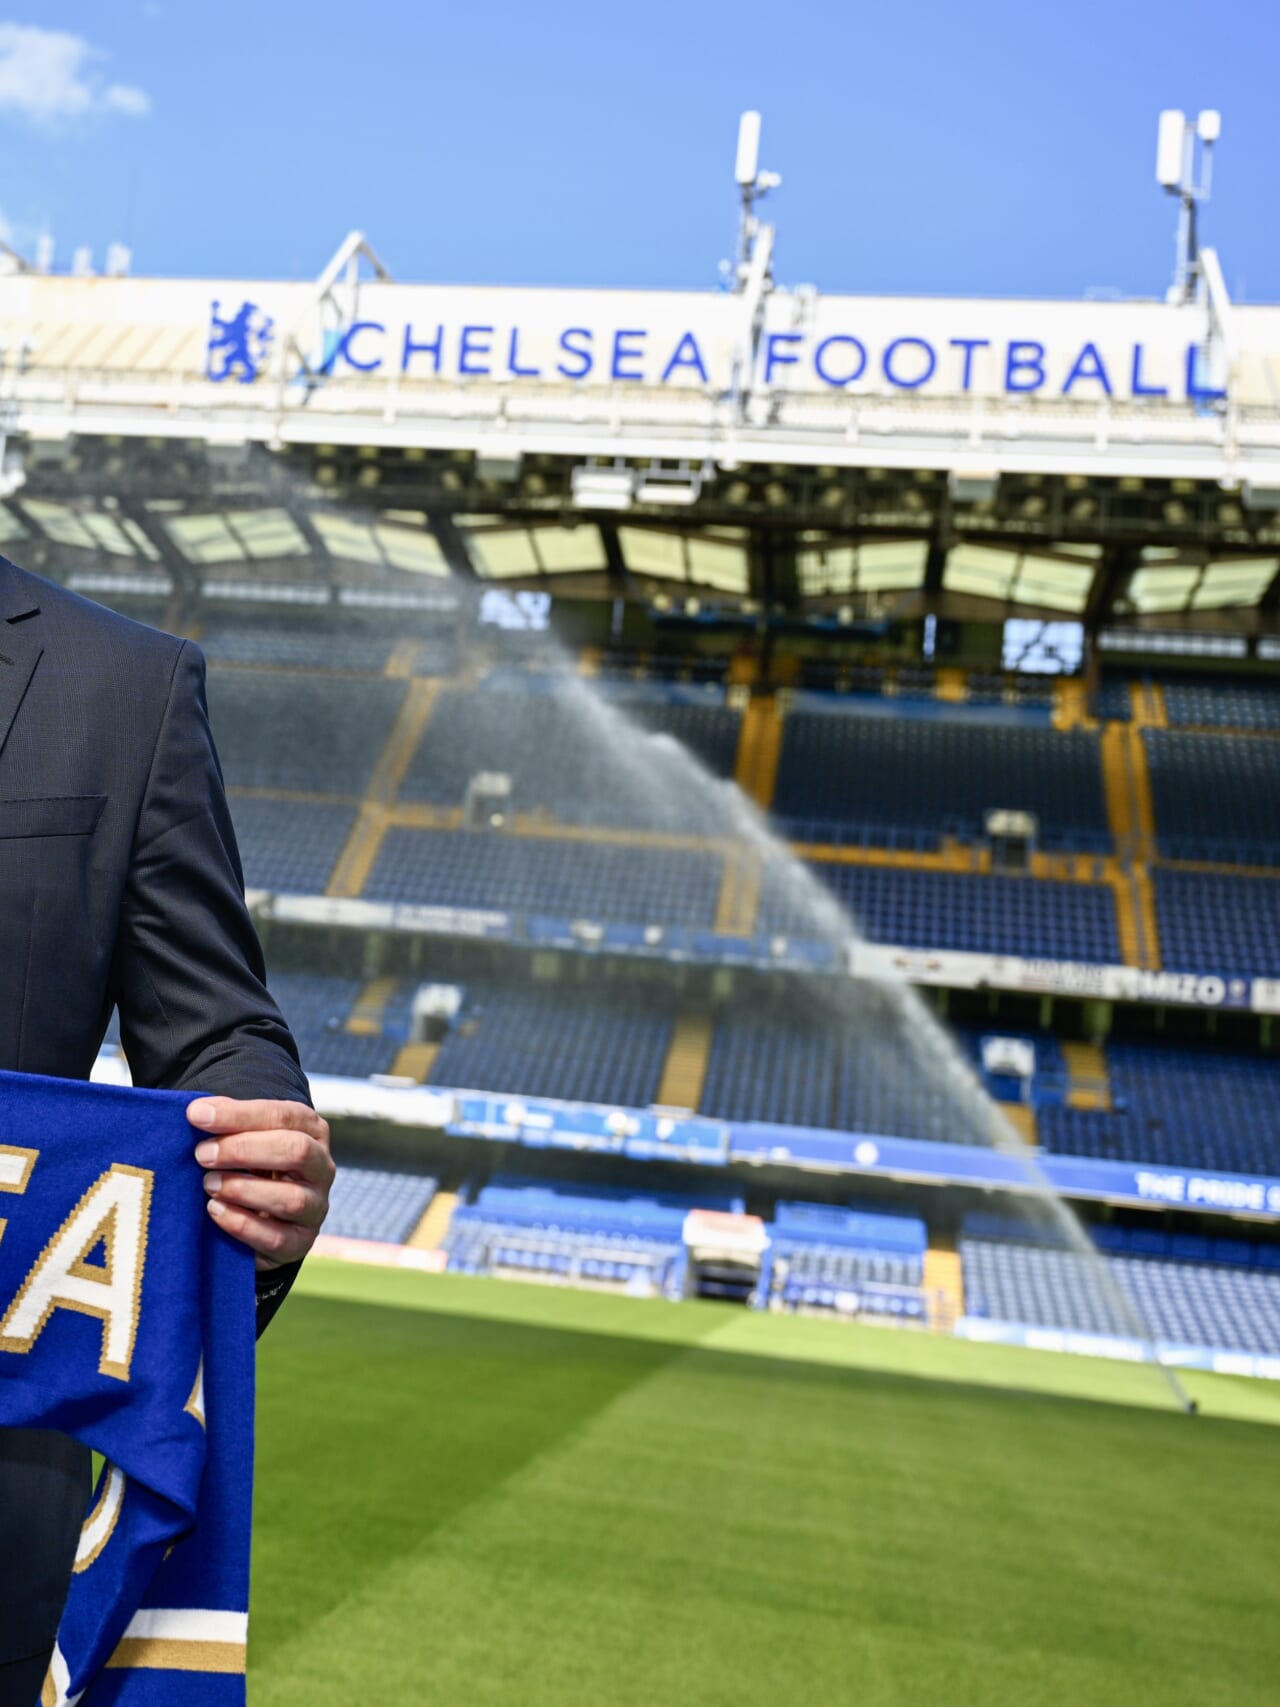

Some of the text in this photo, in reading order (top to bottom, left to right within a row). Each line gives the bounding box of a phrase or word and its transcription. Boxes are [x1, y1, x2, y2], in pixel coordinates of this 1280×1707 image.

[341, 322, 1227, 398] CHELSEA FOOTBALL
[1135, 1171, 1185, 1201] THE
[1188, 1177, 1265, 1210] PRIDE
